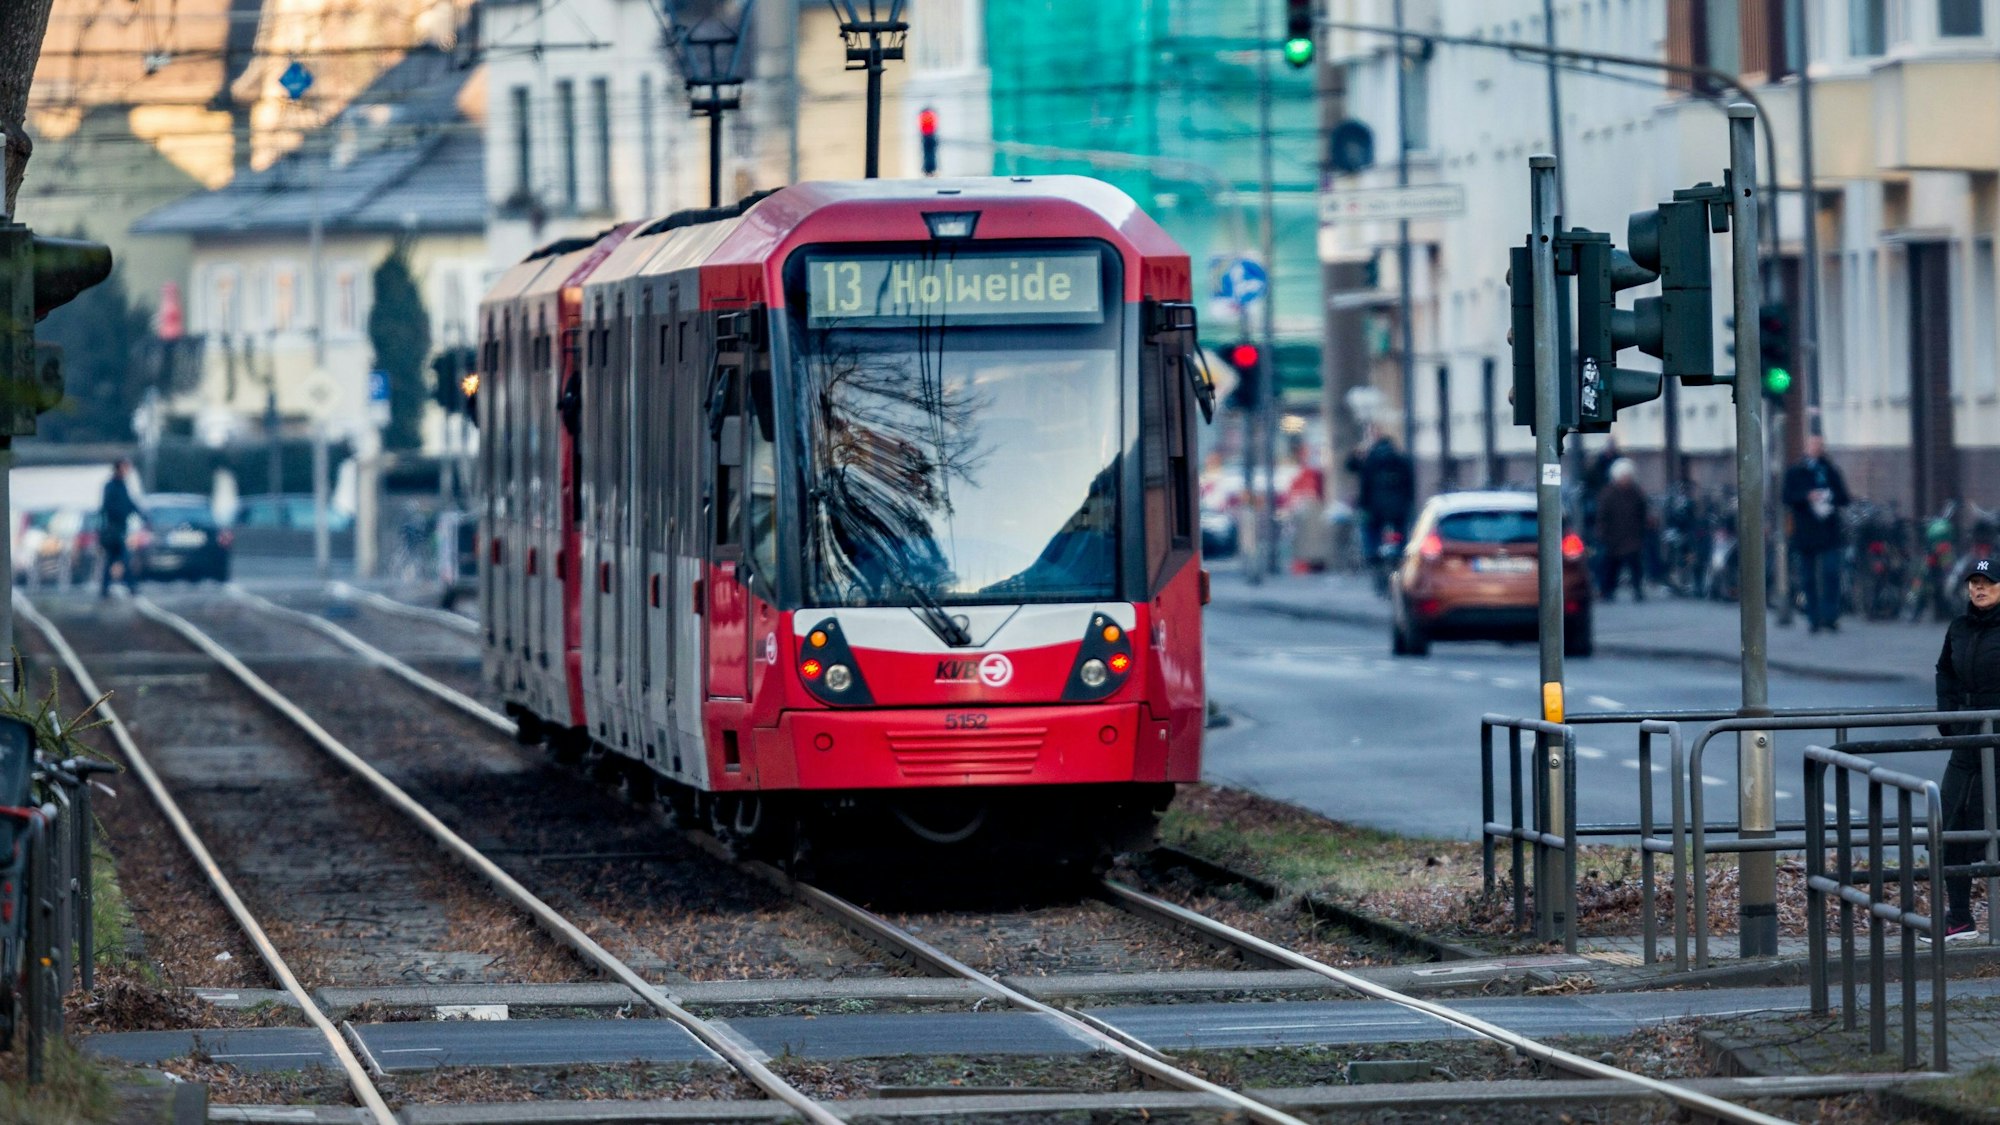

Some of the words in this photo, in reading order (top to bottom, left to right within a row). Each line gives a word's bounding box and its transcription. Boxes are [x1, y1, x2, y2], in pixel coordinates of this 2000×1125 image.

[823, 262, 862, 311] 13
[892, 260, 1072, 303] Holweide
[936, 661, 979, 679] KVB
[945, 713, 988, 730] 5152
